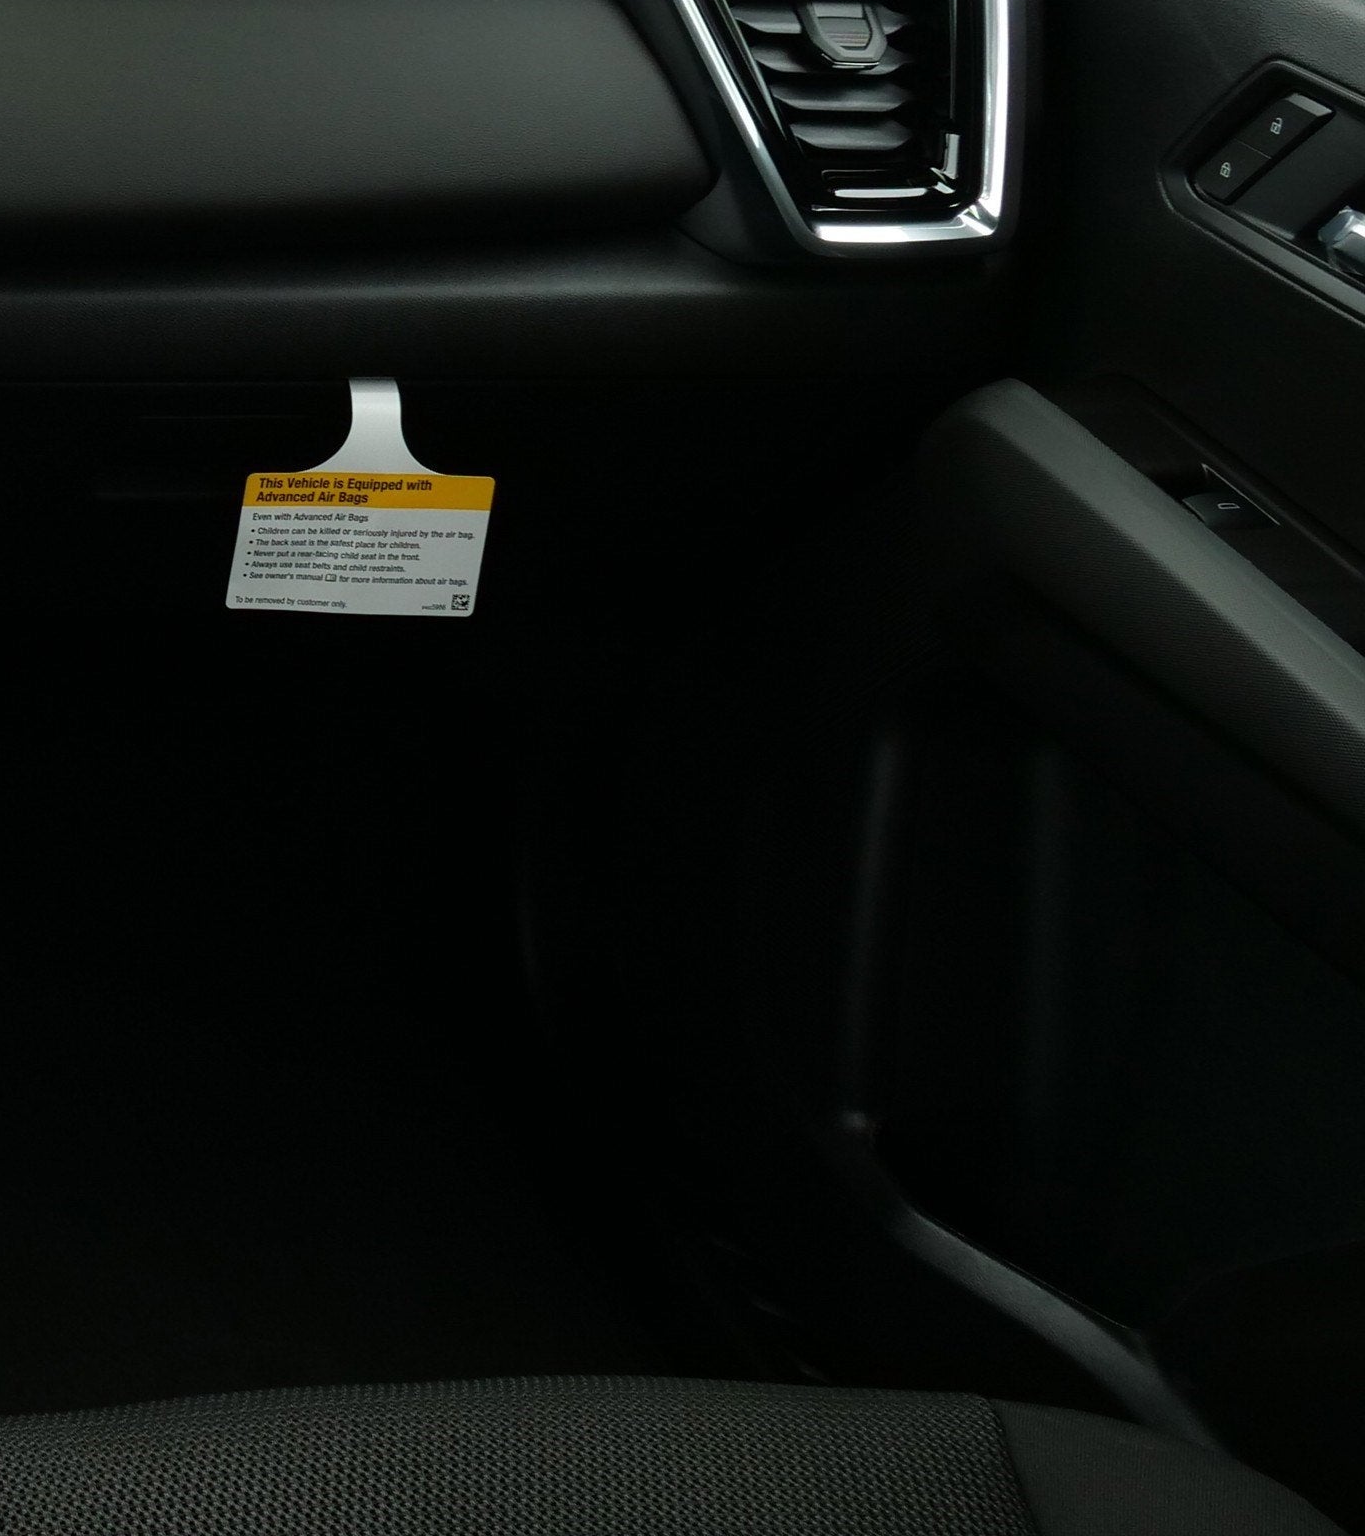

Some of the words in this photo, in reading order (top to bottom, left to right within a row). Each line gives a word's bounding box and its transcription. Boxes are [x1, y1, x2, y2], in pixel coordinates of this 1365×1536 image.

[259, 478, 283, 489] This
[287, 478, 330, 489] Vehicle
[333, 478, 344, 489] is
[347, 478, 403, 491] Equipped
[406, 480, 432, 491] with
[256, 492, 314, 502] Advanced
[318, 492, 335, 502] Air
[338, 492, 369, 505] Bags
[252, 513, 272, 521] Even
[274, 513, 292, 521] with
[293, 513, 333, 521] Advanced
[334, 513, 346, 521] Air
[348, 514, 369, 523] Bags
[257, 527, 289, 535] Children
[353, 529, 388, 538] seriously
[390, 530, 418, 538] injured
[458, 531, 475, 540] bag.
[355, 541, 376, 549] place
[390, 541, 421, 549] children.
[265, 572, 294, 580] owner's
[372, 576, 413, 584] information
[437, 577, 447, 585] air
[287, 597, 295, 605] by
[297, 598, 330, 606] customer
[331, 600, 347, 609] only.
